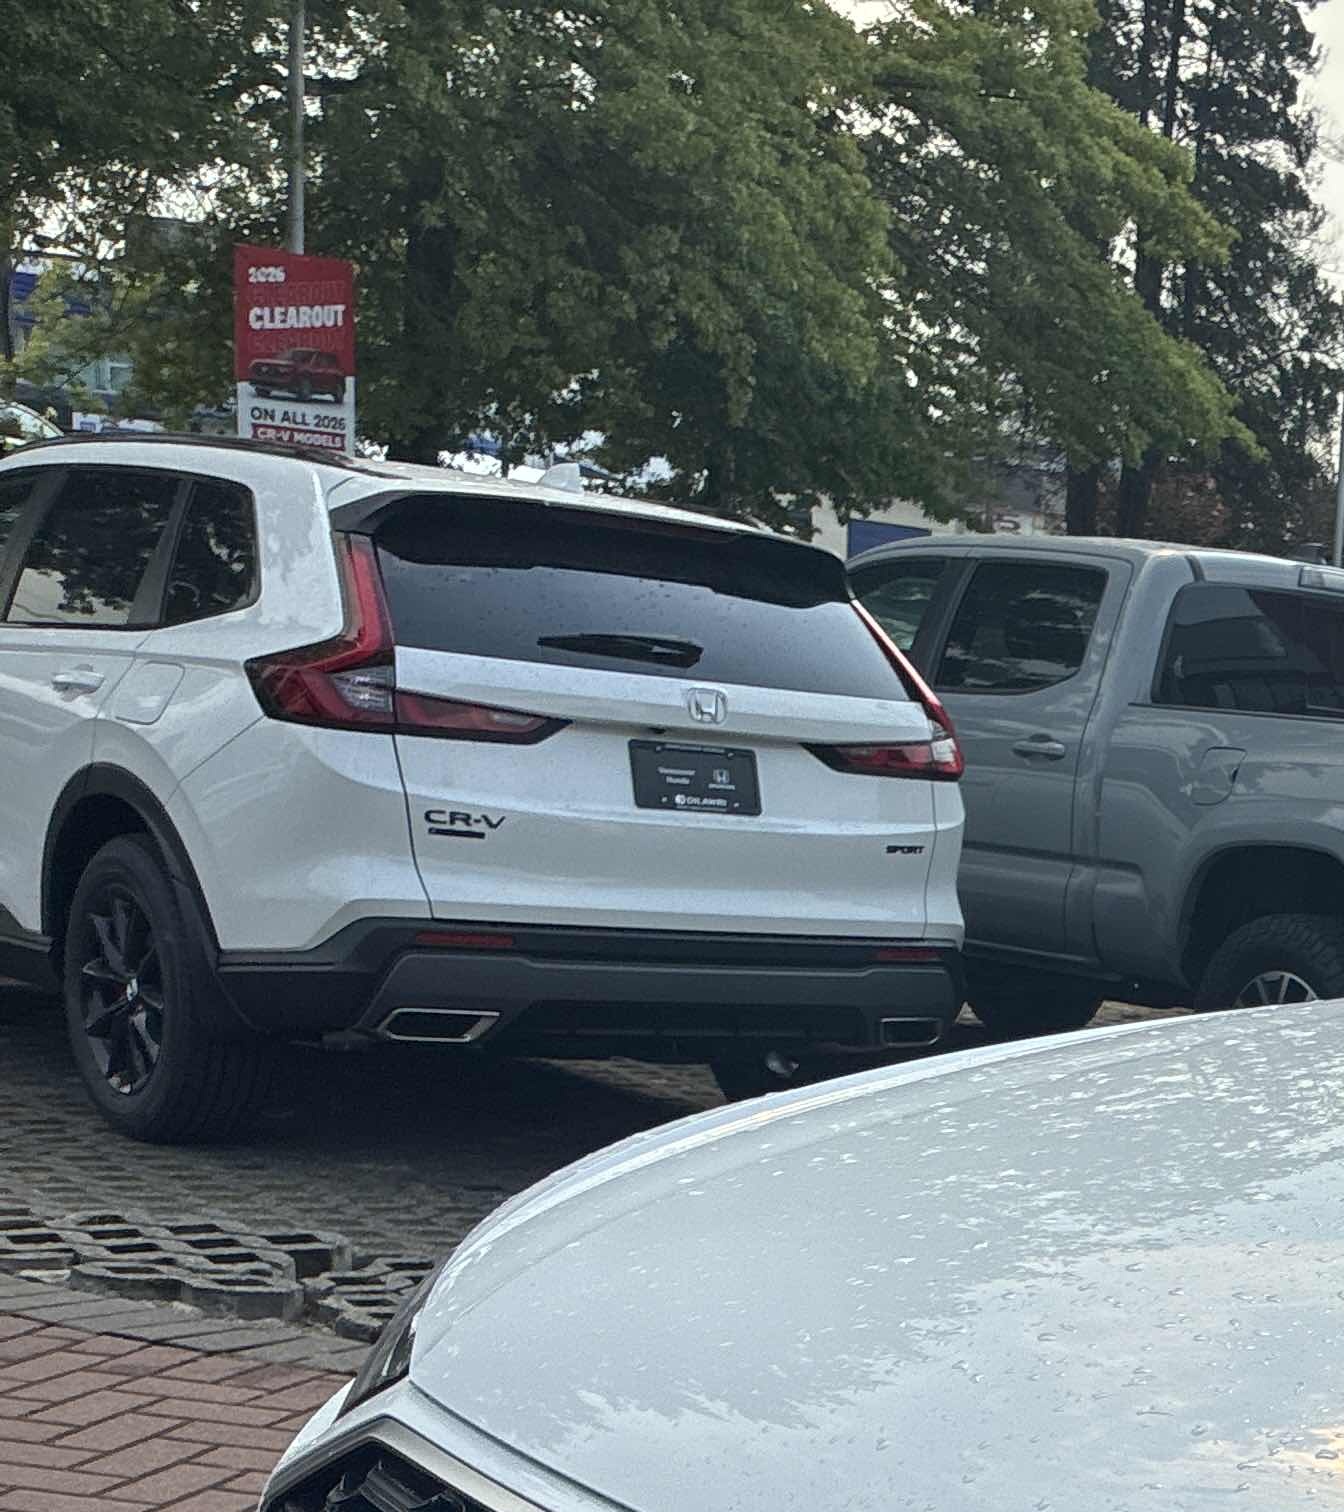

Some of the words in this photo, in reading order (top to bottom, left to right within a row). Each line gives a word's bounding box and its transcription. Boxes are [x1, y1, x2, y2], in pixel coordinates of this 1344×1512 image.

[249, 304, 346, 330] CLEAROUT
[251, 406, 276, 423] ON
[281, 409, 310, 427] ALL
[256, 427, 290, 442] CR-V
[294, 432, 341, 447] MODELS
[424, 810, 506, 829] CR-V
[886, 845, 925, 855] SPORT
